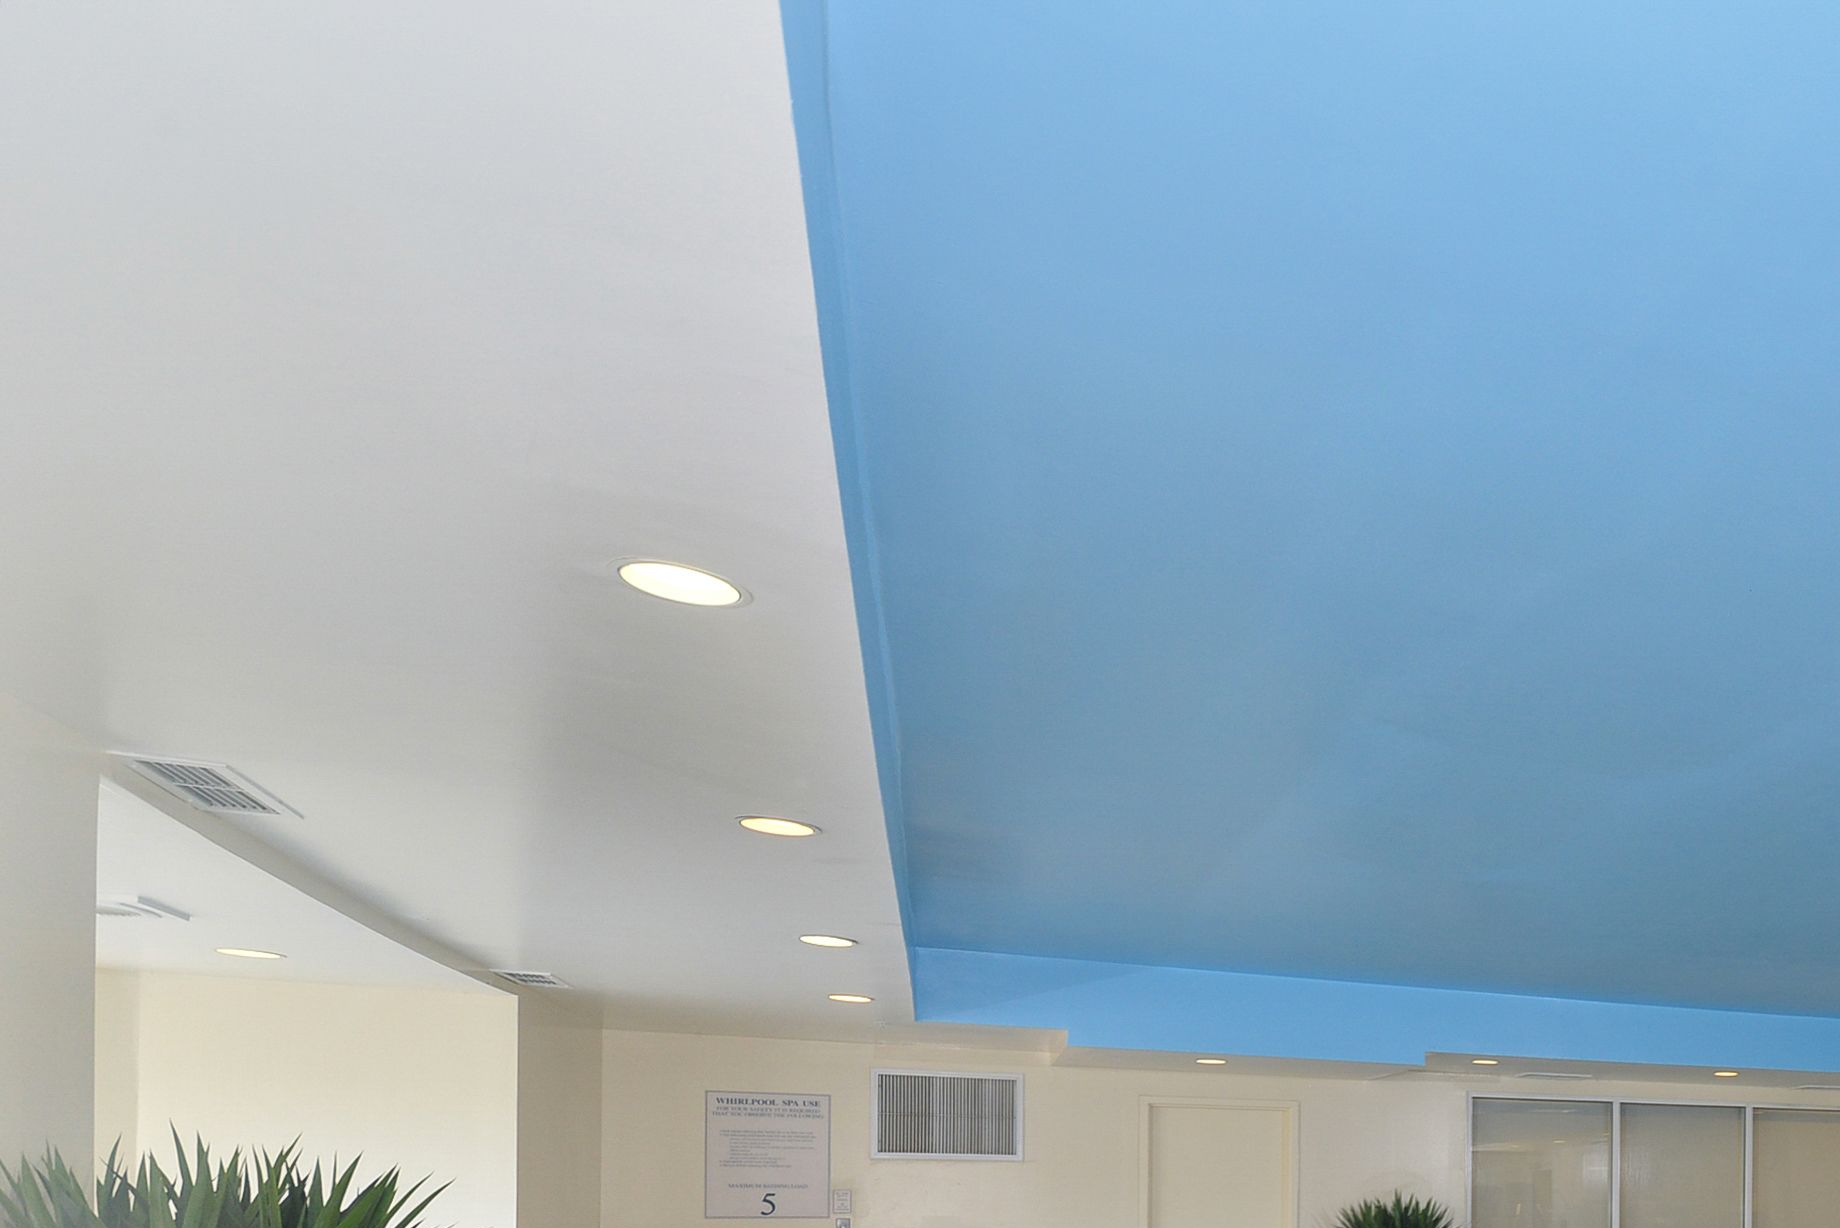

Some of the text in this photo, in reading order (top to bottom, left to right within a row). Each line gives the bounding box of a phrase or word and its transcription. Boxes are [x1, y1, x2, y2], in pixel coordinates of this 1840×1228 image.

[716, 1097, 820, 1107] WHIRLPOOL SPA USE
[760, 1193, 776, 1216] 5
